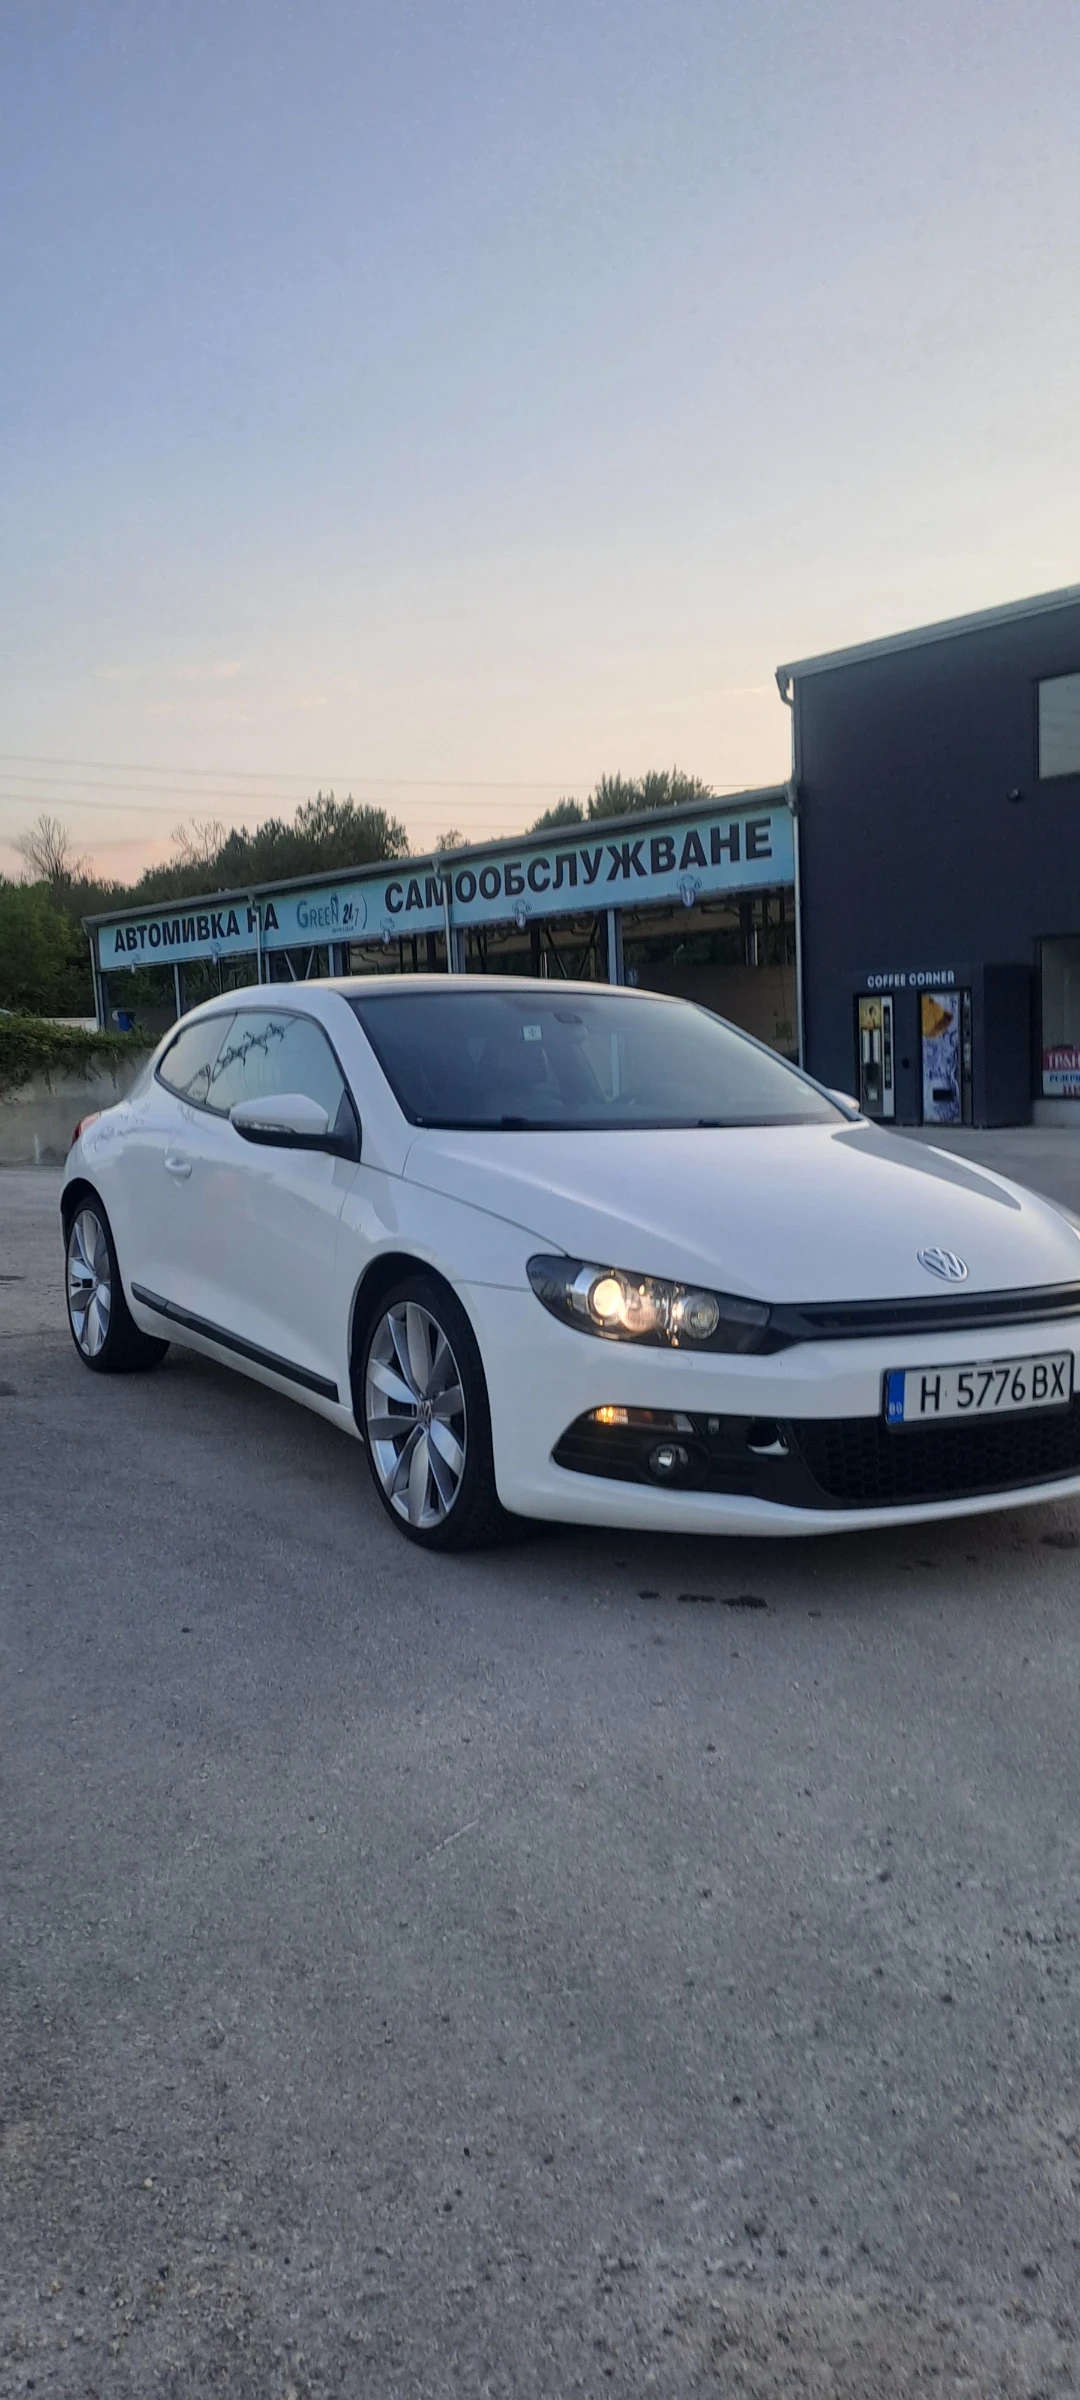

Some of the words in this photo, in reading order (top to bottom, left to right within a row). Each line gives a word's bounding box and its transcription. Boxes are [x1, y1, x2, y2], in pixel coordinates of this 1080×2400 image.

[114, 908, 240, 952] АВТОМИВКА
[247, 902, 279, 934] НА
[384, 816, 773, 914] САМООБСЛУЖВАНЕ
[867, 973, 906, 988] COFFEE
[909, 969, 955, 986] CORNER
[957, 1367, 1027, 1408] 5776
